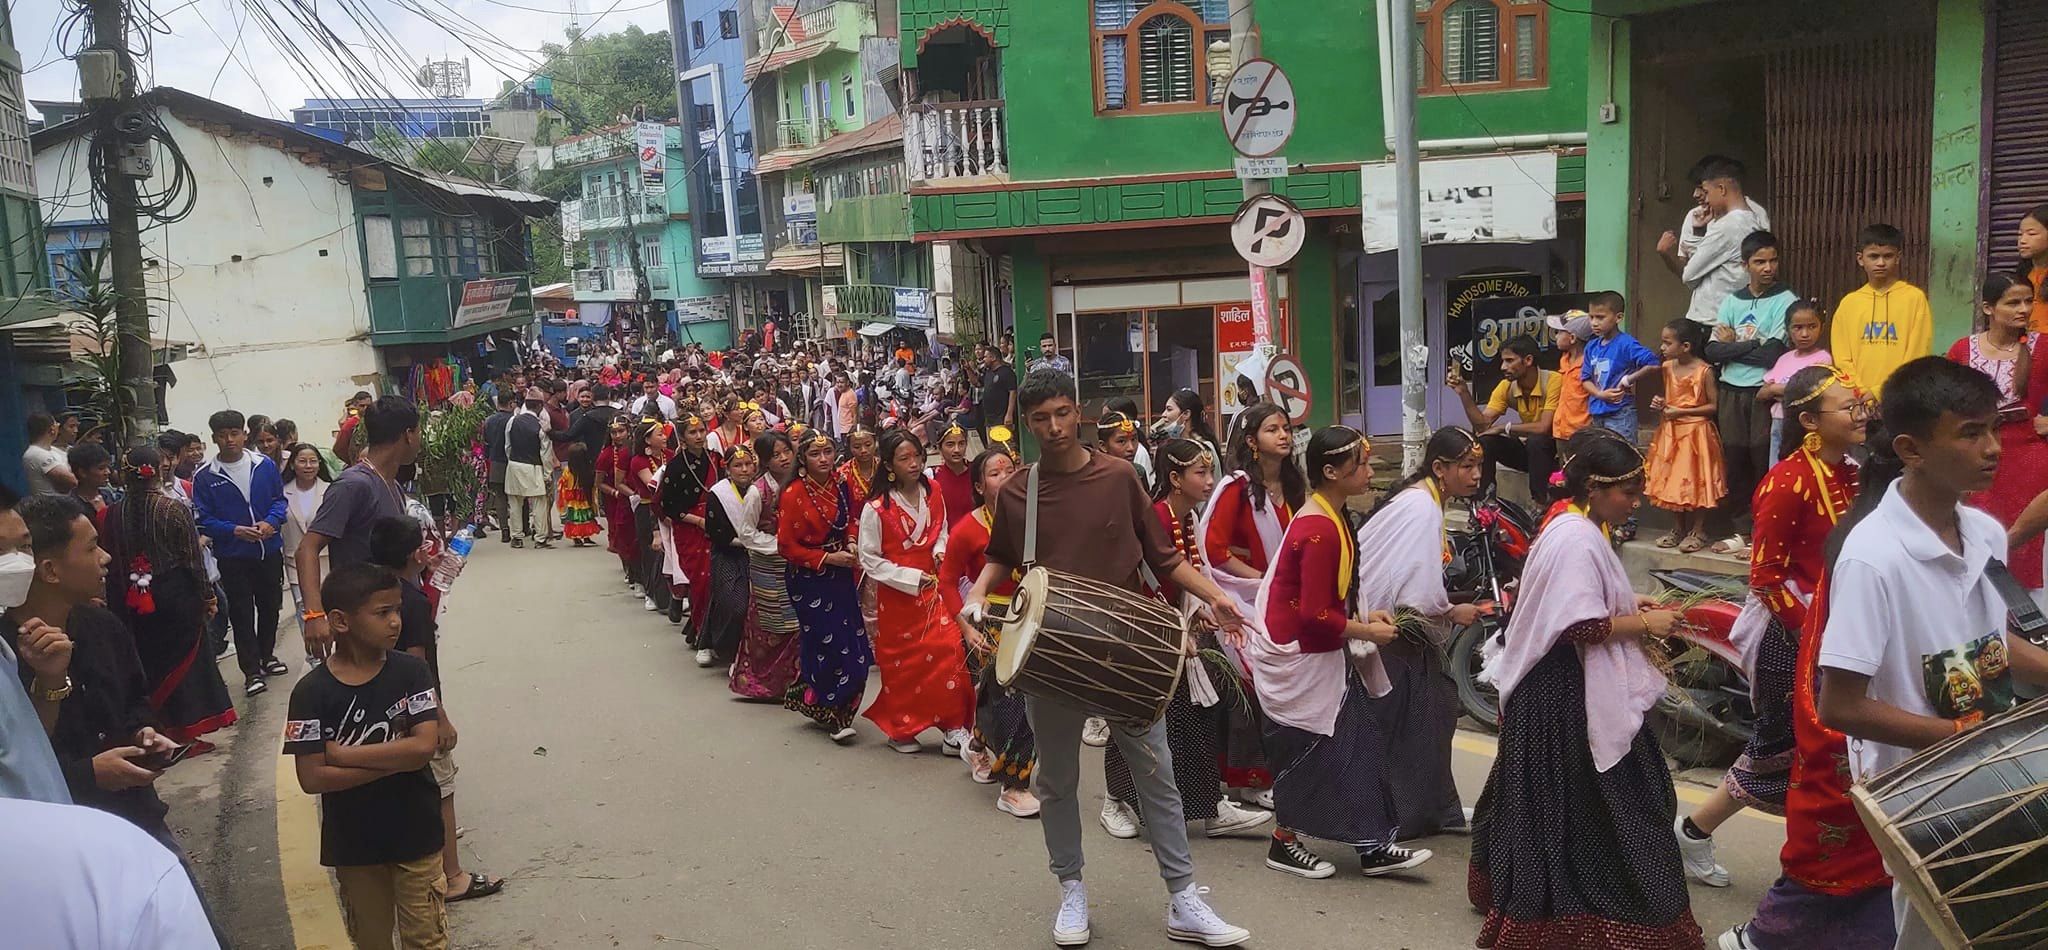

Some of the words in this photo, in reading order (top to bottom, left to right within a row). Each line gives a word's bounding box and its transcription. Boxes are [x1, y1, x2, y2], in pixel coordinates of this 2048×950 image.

[136, 157, 150, 172] 36
[1448, 280, 1502, 318] HANDSOME
[1220, 306, 1251, 323] शाहिल
